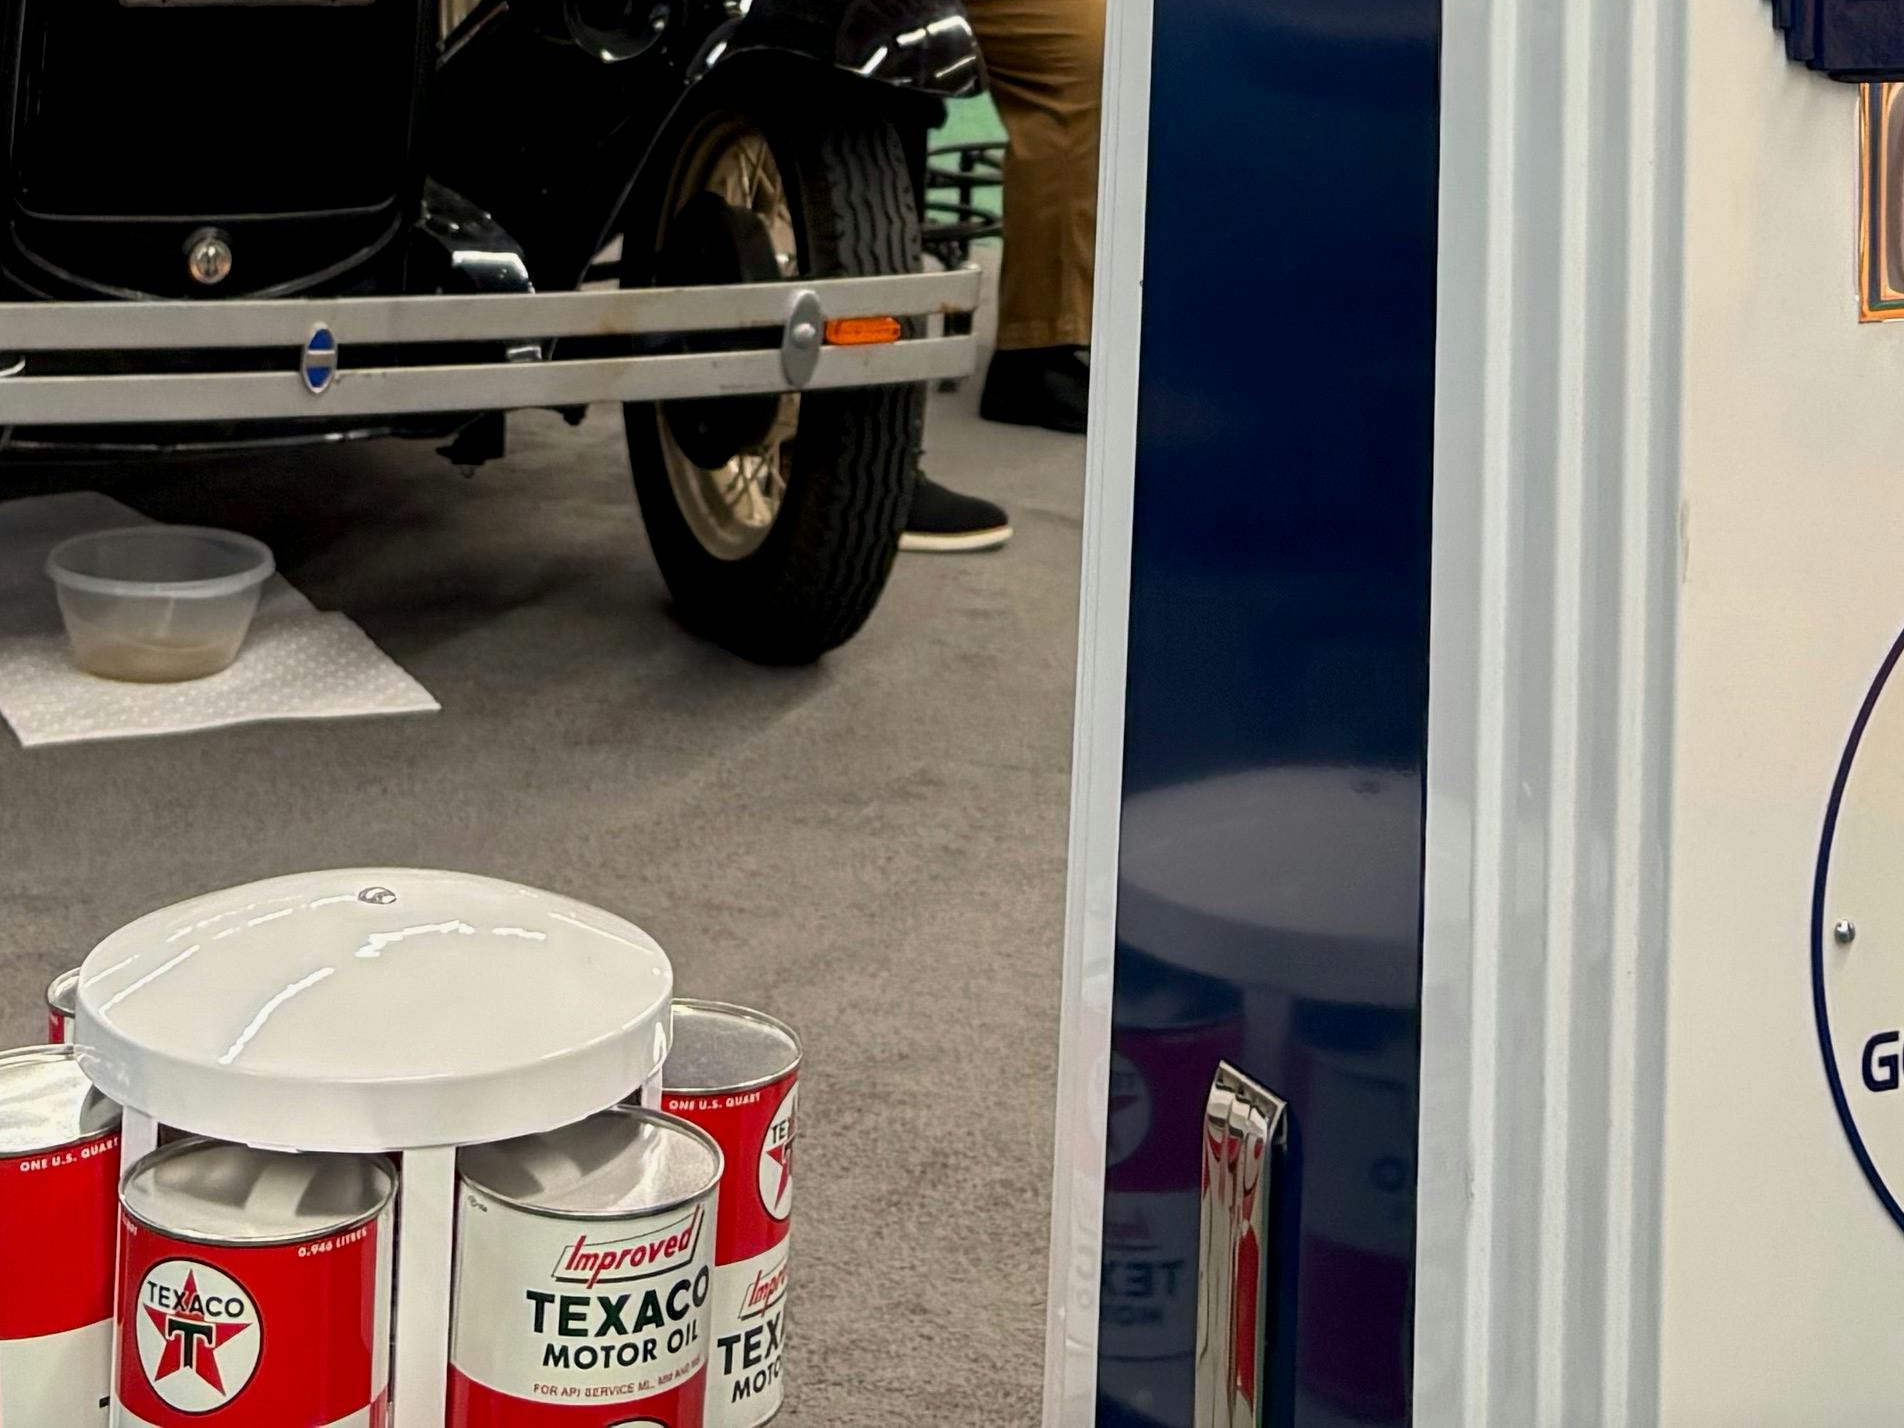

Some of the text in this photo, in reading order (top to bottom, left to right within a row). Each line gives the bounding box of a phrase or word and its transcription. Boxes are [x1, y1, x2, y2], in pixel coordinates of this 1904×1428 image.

[669, 1092, 761, 1111] ONE U.S. QUART
[19, 1137, 119, 1172] ONE U.S. QUART
[297, 1227, 368, 1258] 0.946 LITRES
[565, 1227, 693, 1289] Improved
[146, 1280, 245, 1319] TEXACO
[526, 1265, 710, 1338] TEXACO
[167, 1318, 215, 1370] T
[542, 1319, 699, 1370] MOTOR OIL
[533, 1382, 558, 1396] FOR
[584, 1382, 635, 1398] SERVICE
